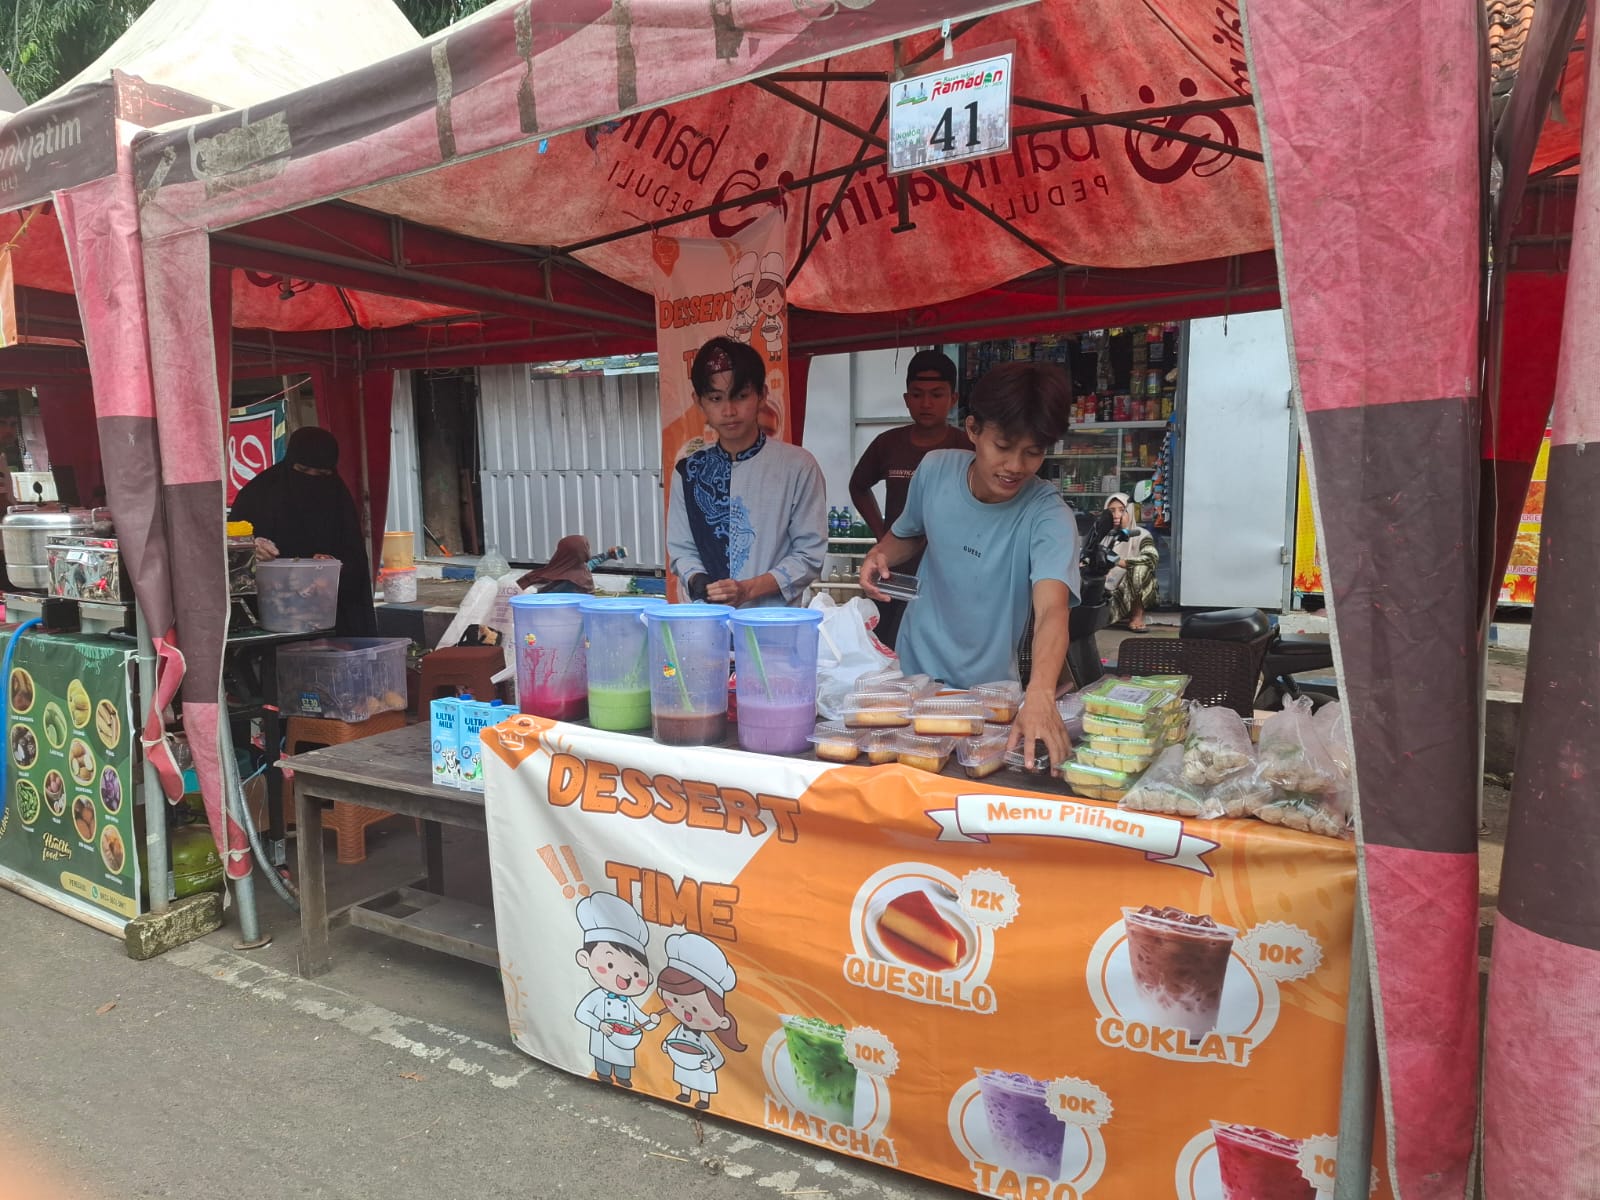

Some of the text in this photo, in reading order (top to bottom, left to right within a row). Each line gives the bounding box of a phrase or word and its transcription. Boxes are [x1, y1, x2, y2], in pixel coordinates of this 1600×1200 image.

[929, 101, 981, 152] 41
[0, 115, 82, 172] nkjatim
[659, 290, 734, 330] DESSERT
[963, 545, 982, 558] GUESS
[435, 712, 455, 722] ULTRA
[438, 720, 453, 729] MILK
[464, 717, 488, 727] ULTRA
[467, 725, 483, 734] MIL
[547, 753, 800, 843] DESSERT
[986, 802, 1146, 839] Menu Pilihan
[604, 860, 740, 942] TIME
[969, 888, 1006, 913] 12K
[1259, 942, 1304, 966] 10K
[845, 957, 992, 1012] QUESILLO
[854, 1042, 887, 1066] 10K
[1099, 1016, 1253, 1064] COKLAT
[1058, 1092, 1097, 1115] 10K
[767, 1100, 896, 1165] MATCHA
[974, 1161, 1078, 1200] TARO
[1313, 1154, 1337, 1178] 10
